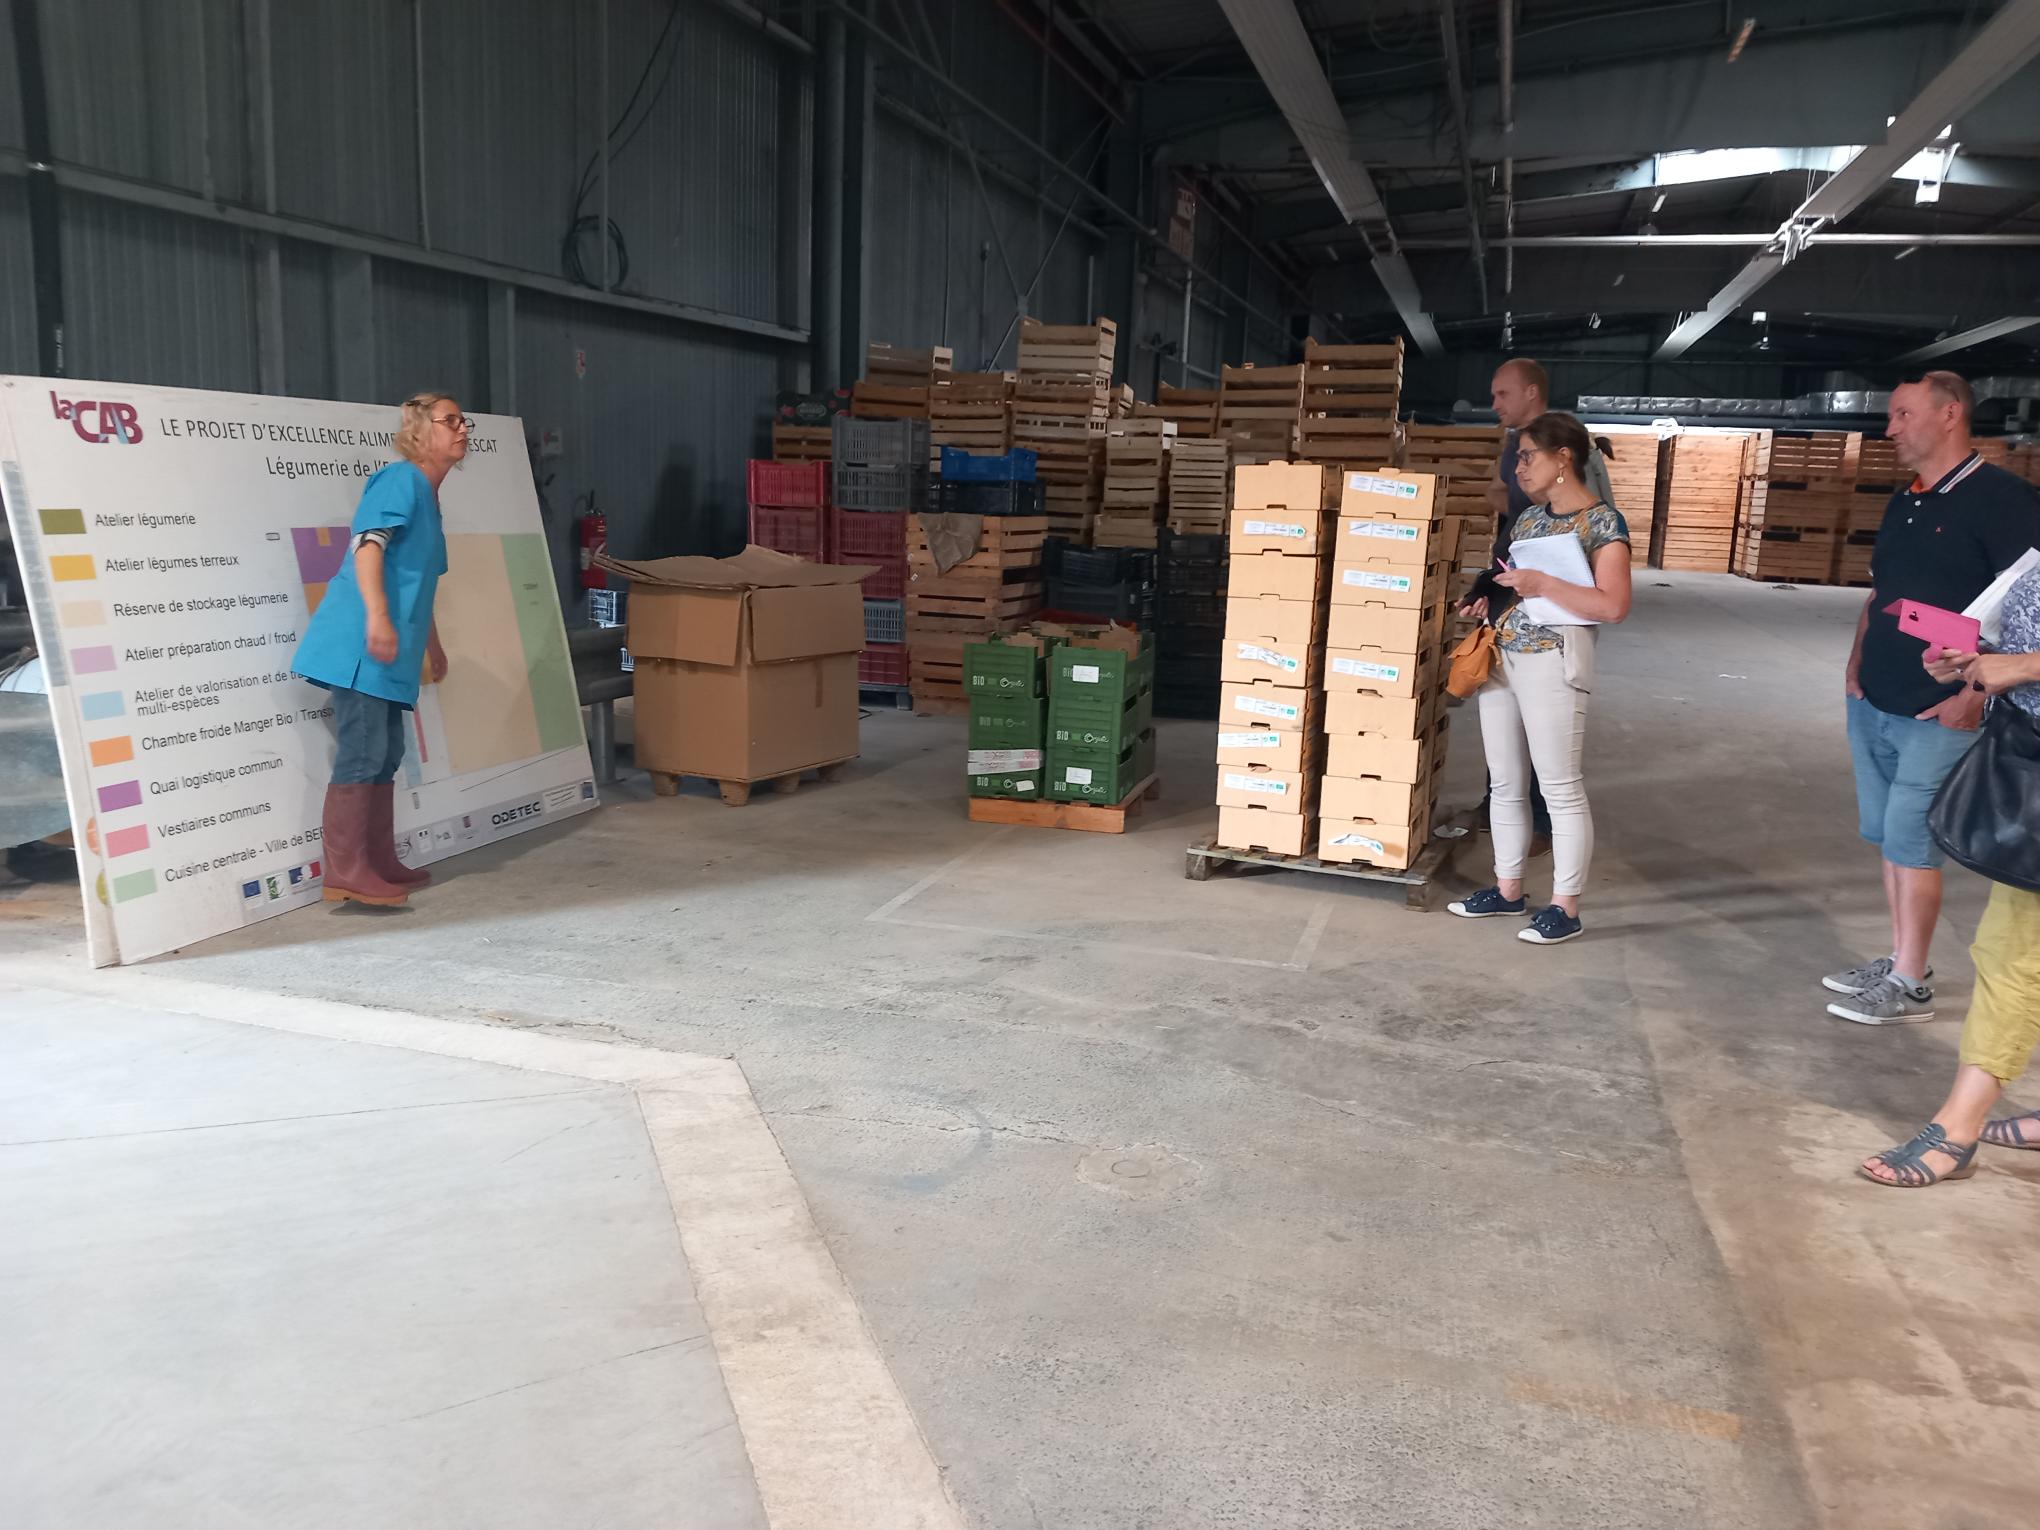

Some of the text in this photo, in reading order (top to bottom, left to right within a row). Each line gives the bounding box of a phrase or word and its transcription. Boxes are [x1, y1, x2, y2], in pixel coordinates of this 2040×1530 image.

[160, 418, 181, 437] LE
[186, 419, 246, 440] PROJET
[251, 423, 355, 446] D'EXCELLENCE
[266, 455, 350, 480] Légumerie
[353, 459, 371, 477] de
[95, 512, 197, 529] Atelier légumerie
[105, 553, 240, 573] Atelier légumes terreux
[113, 591, 289, 617] Réserve de stockage légumerie
[125, 645, 164, 662] Atelier
[168, 639, 231, 660] préparation
[234, 633, 266, 650] chaud
[274, 630, 297, 644] froid
[135, 686, 175, 704] Atelier
[178, 684, 193, 698] de
[197, 672, 259, 694] valorisation
[262, 672, 272, 684] et
[275, 670, 288, 682] de
[137, 694, 220, 718] multi-espèces
[142, 730, 197, 751] Chambre
[200, 723, 232, 740] froide
[234, 715, 274, 733] Manger
[276, 711, 293, 726] Bio
[150, 757, 284, 796] Quai logistique commun
[158, 801, 272, 838] Vestiaires communs
[491, 801, 541, 826] ODETEC
[165, 859, 210, 882] Cuisine
[212, 847, 257, 870] centrale
[264, 838, 288, 854] Ville
[290, 832, 304, 847] de
